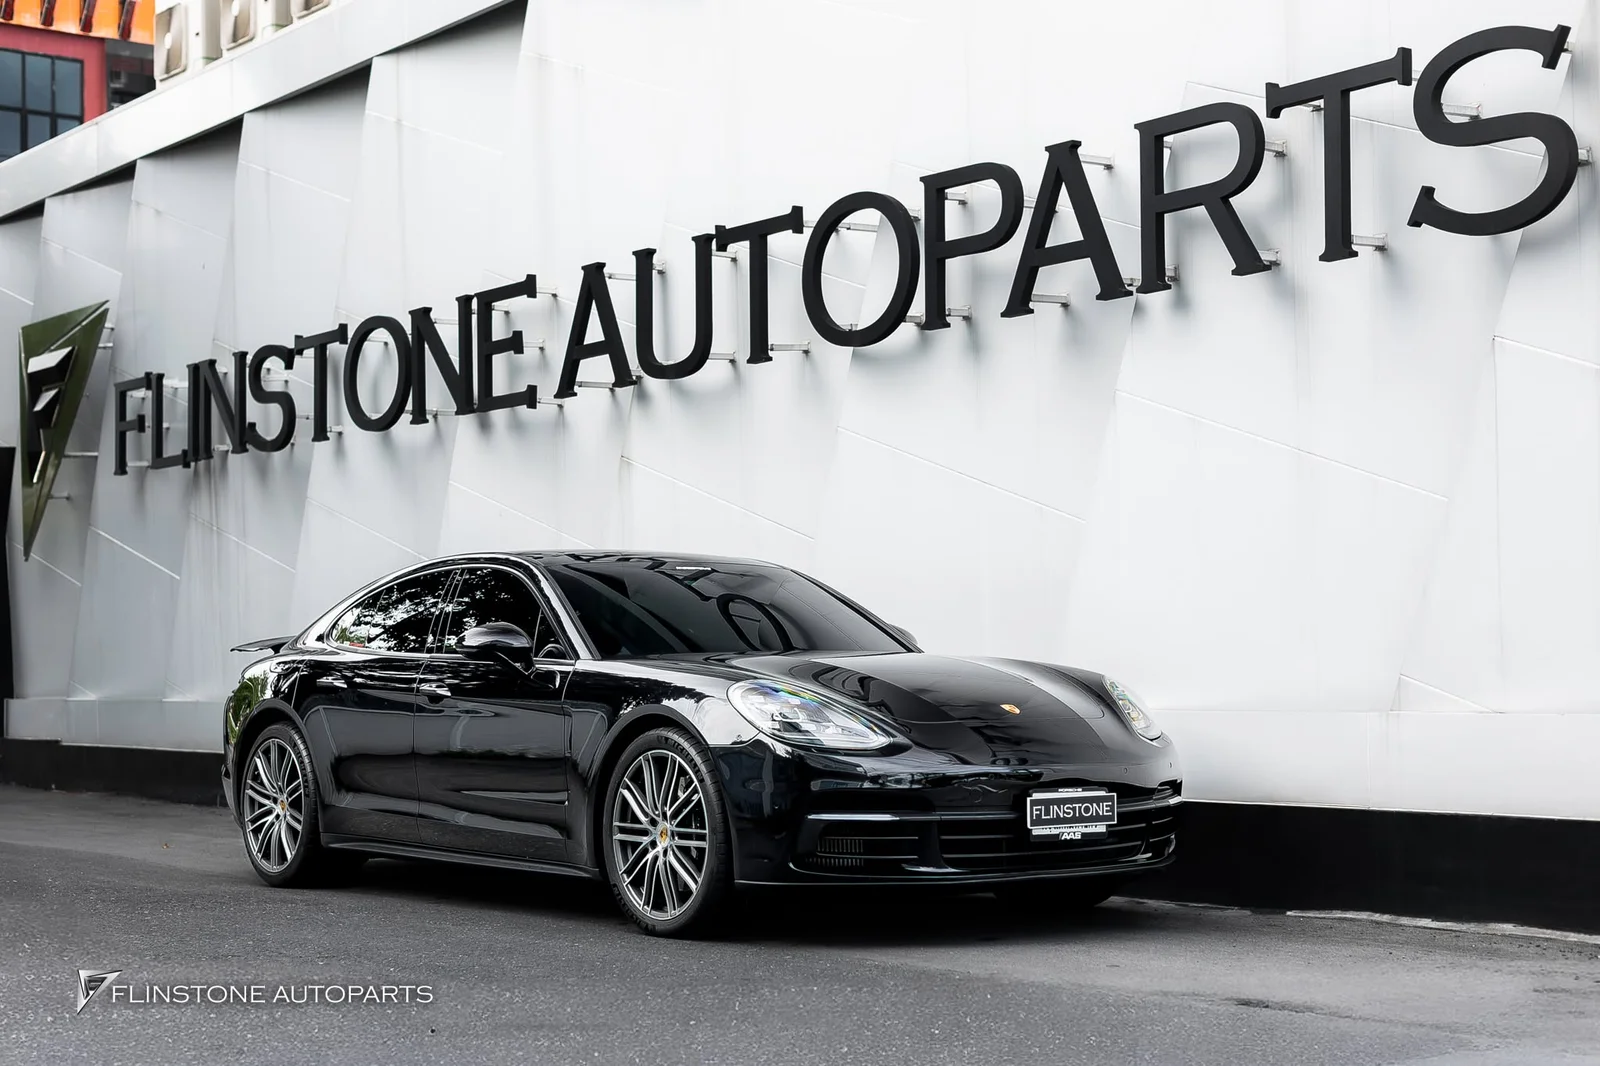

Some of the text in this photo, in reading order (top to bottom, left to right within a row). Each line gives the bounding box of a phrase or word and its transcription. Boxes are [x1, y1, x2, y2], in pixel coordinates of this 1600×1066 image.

[114, 24, 1577, 475] FLINSTONE AUTOPARTS
[1032, 802, 1112, 820] FLINSTONE
